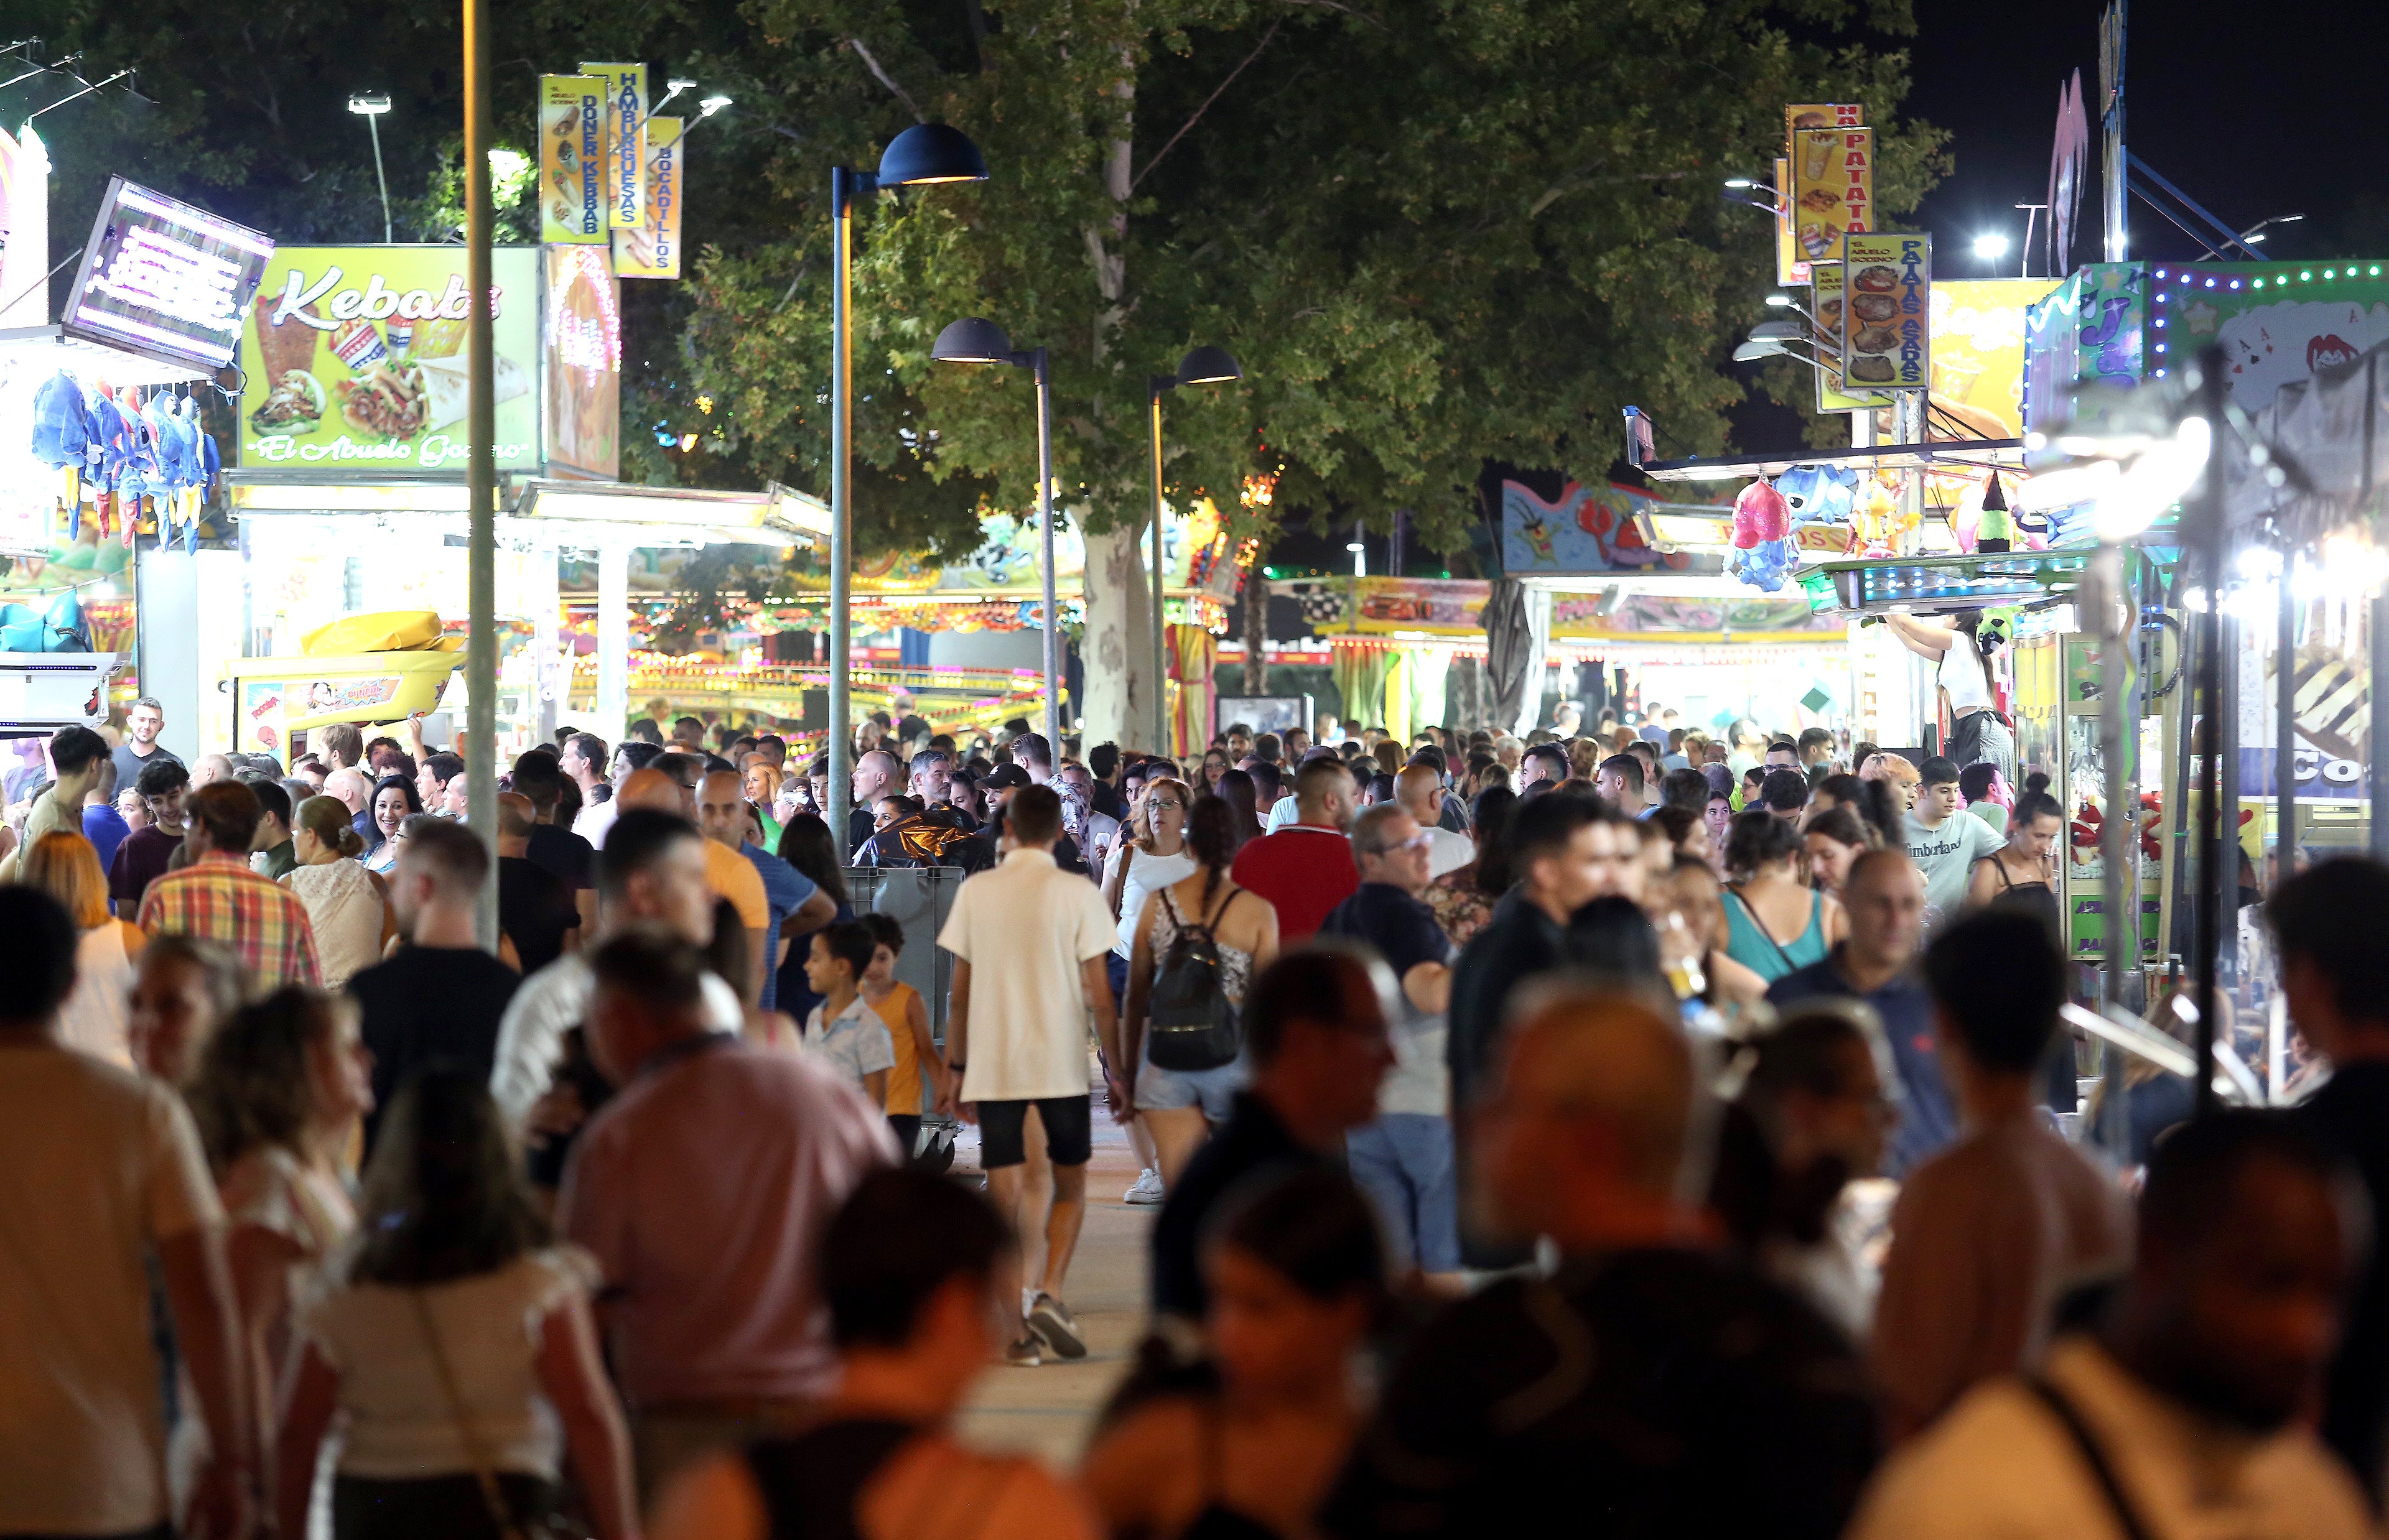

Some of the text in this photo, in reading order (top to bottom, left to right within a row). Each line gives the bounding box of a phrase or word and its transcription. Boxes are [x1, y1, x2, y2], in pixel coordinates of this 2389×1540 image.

[582, 95, 598, 234] DONER KEBBAB
[618, 73, 638, 223] HAMBURGUESAS
[656, 148, 673, 268] BOCADILLOS
[1899, 241, 1922, 383] PATATAS ASADAS
[299, 434, 412, 462] Abuelo
[2293, 749, 2373, 782] Co
